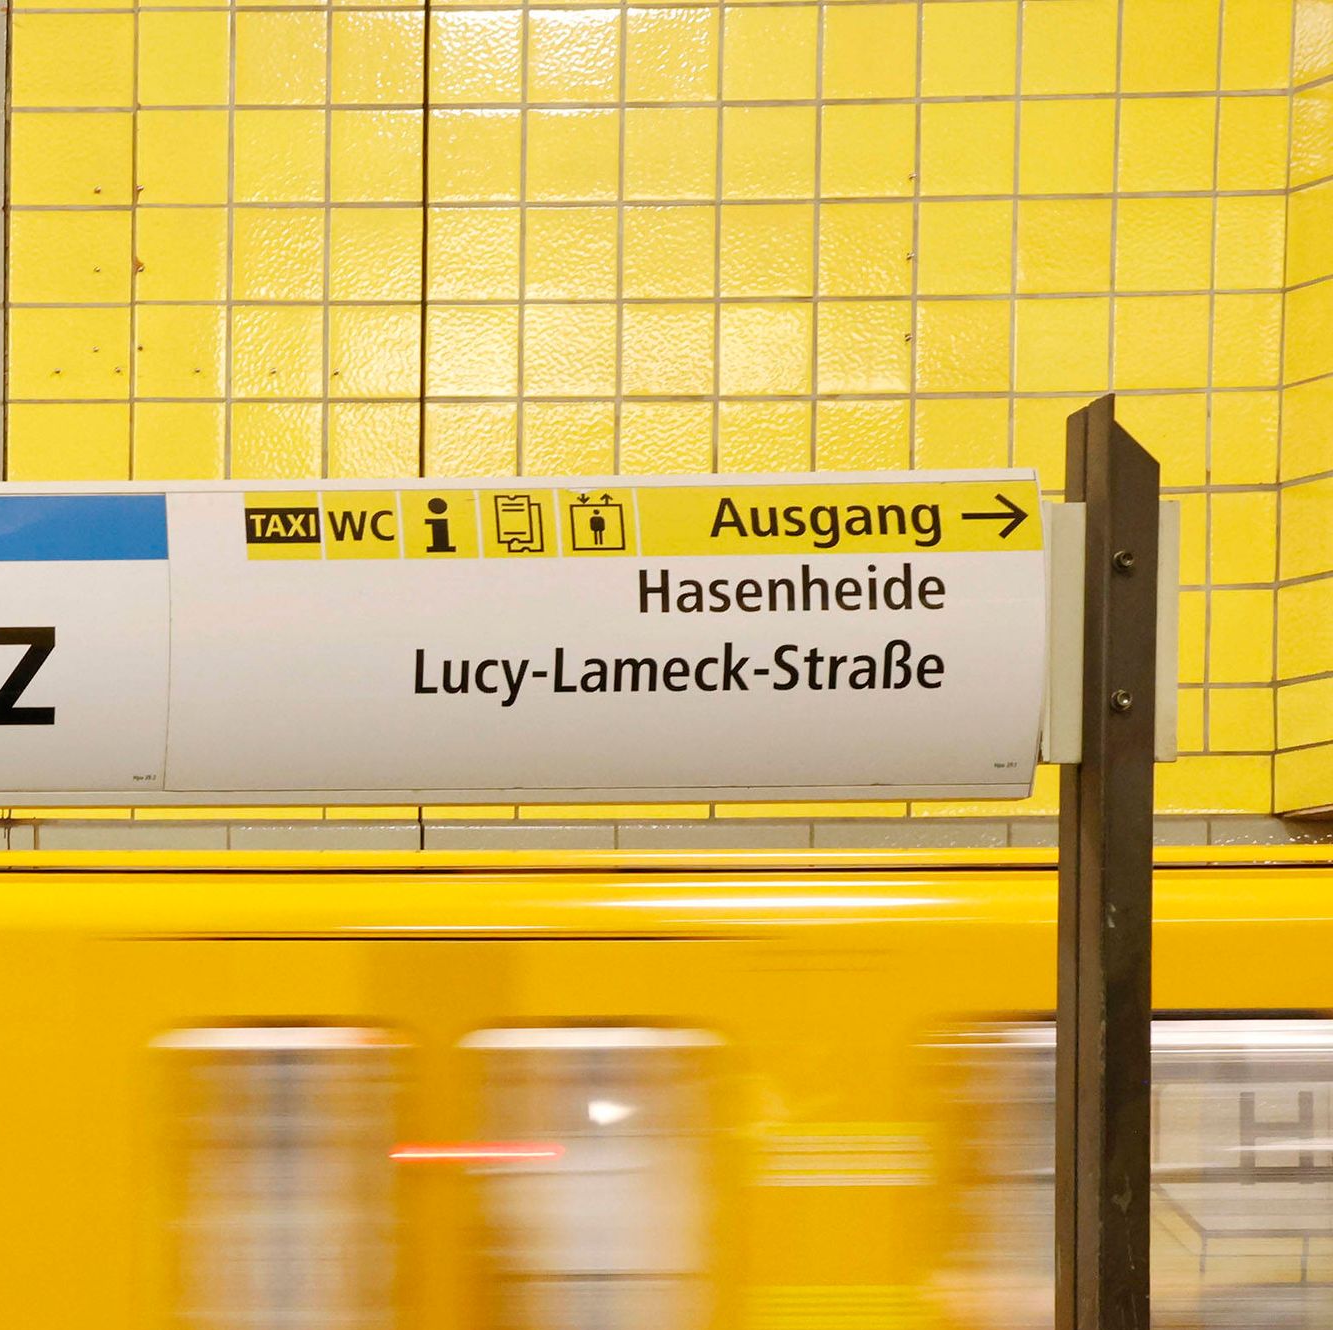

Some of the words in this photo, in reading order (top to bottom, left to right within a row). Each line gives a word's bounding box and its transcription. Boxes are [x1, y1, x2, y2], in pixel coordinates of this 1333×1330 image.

[250, 514, 317, 538] TAXI
[327, 511, 396, 542] WC
[711, 497, 942, 548] Ausgang
[638, 563, 946, 614] Hasenheide
[414, 639, 945, 707] Lucy-Lameck-Straße
